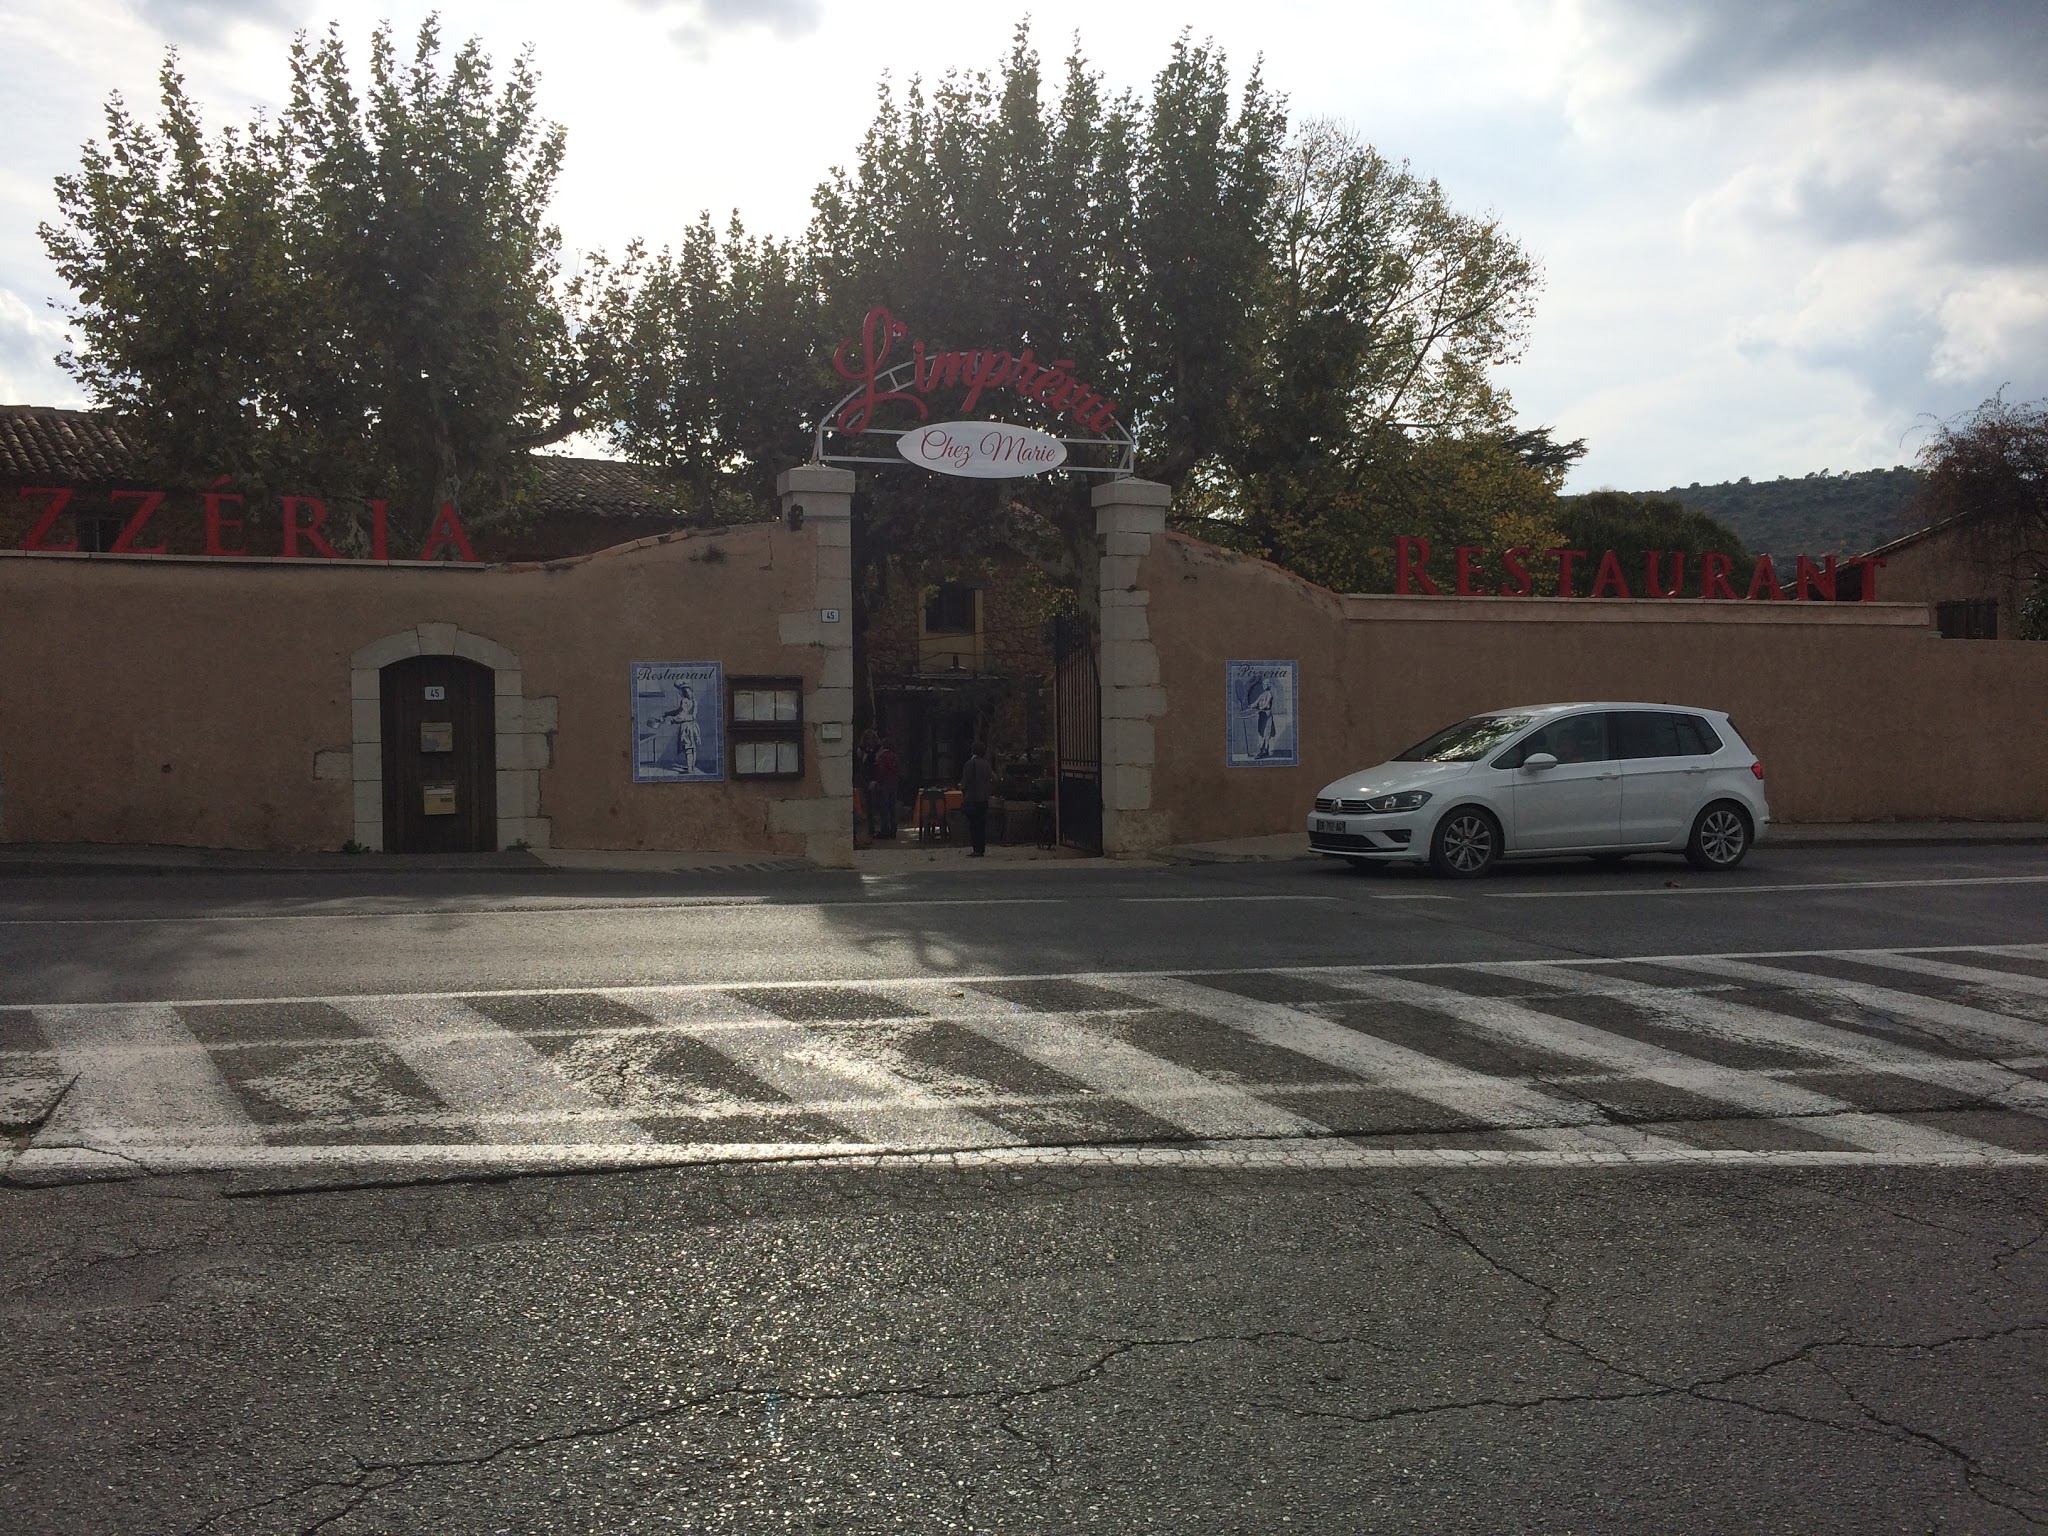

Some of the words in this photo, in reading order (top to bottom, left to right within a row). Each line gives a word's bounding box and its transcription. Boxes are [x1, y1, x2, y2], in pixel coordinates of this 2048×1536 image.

[834, 307, 1118, 434] L'imprévu
[921, 430, 974, 468] Chez
[979, 432, 1057, 464] Marie
[18, 474, 482, 562] ZZÉRIA
[1396, 535, 1887, 602] RESTAURANT
[826, 611, 835, 620] 45
[637, 666, 715, 681] Restaurant
[1238, 664, 1288, 683] Pizzeria
[430, 688, 440, 698] 45
